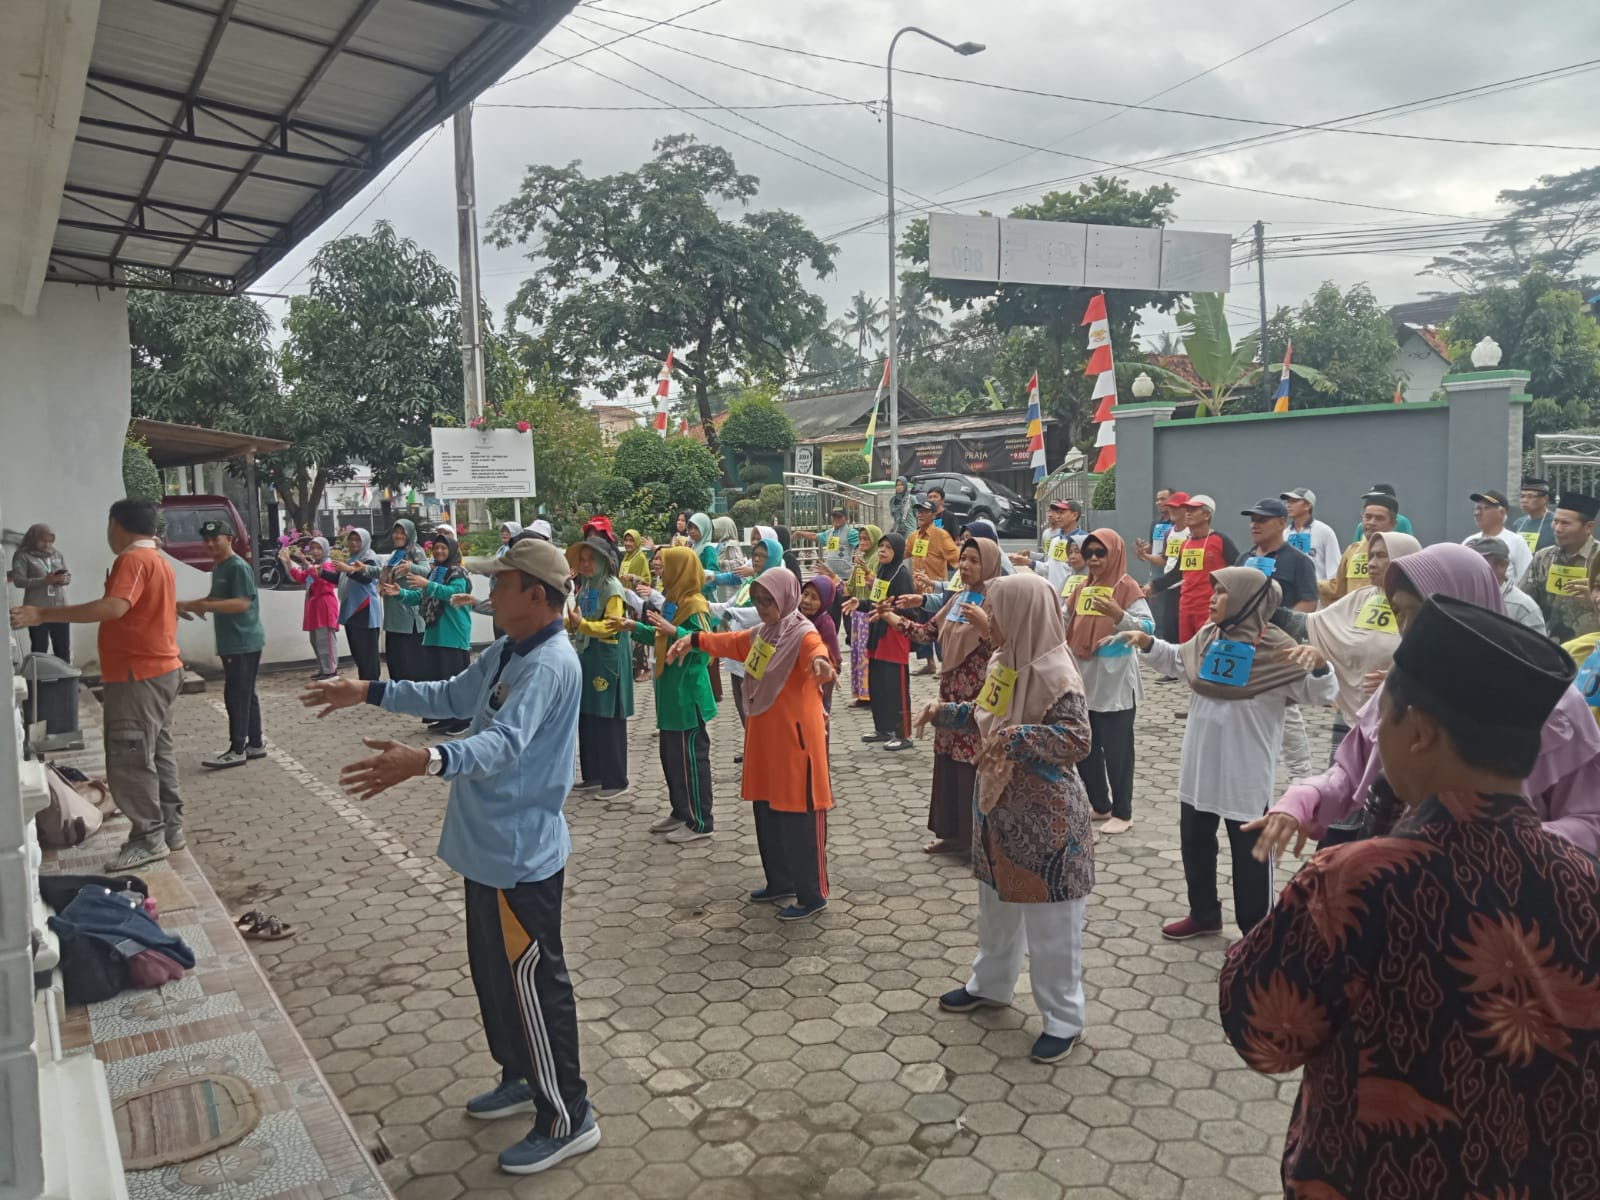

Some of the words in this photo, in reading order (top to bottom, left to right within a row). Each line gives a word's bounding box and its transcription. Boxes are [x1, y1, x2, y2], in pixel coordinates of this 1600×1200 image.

[1054, 548, 1064, 558] 07
[1170, 546, 1179, 554] 14
[1185, 557, 1197, 568] 04
[1354, 563, 1368, 575] 36
[1366, 608, 1392, 627] 26
[749, 652, 760, 672] 21
[1211, 657, 1236, 679] 12
[986, 682, 1001, 707] 25
